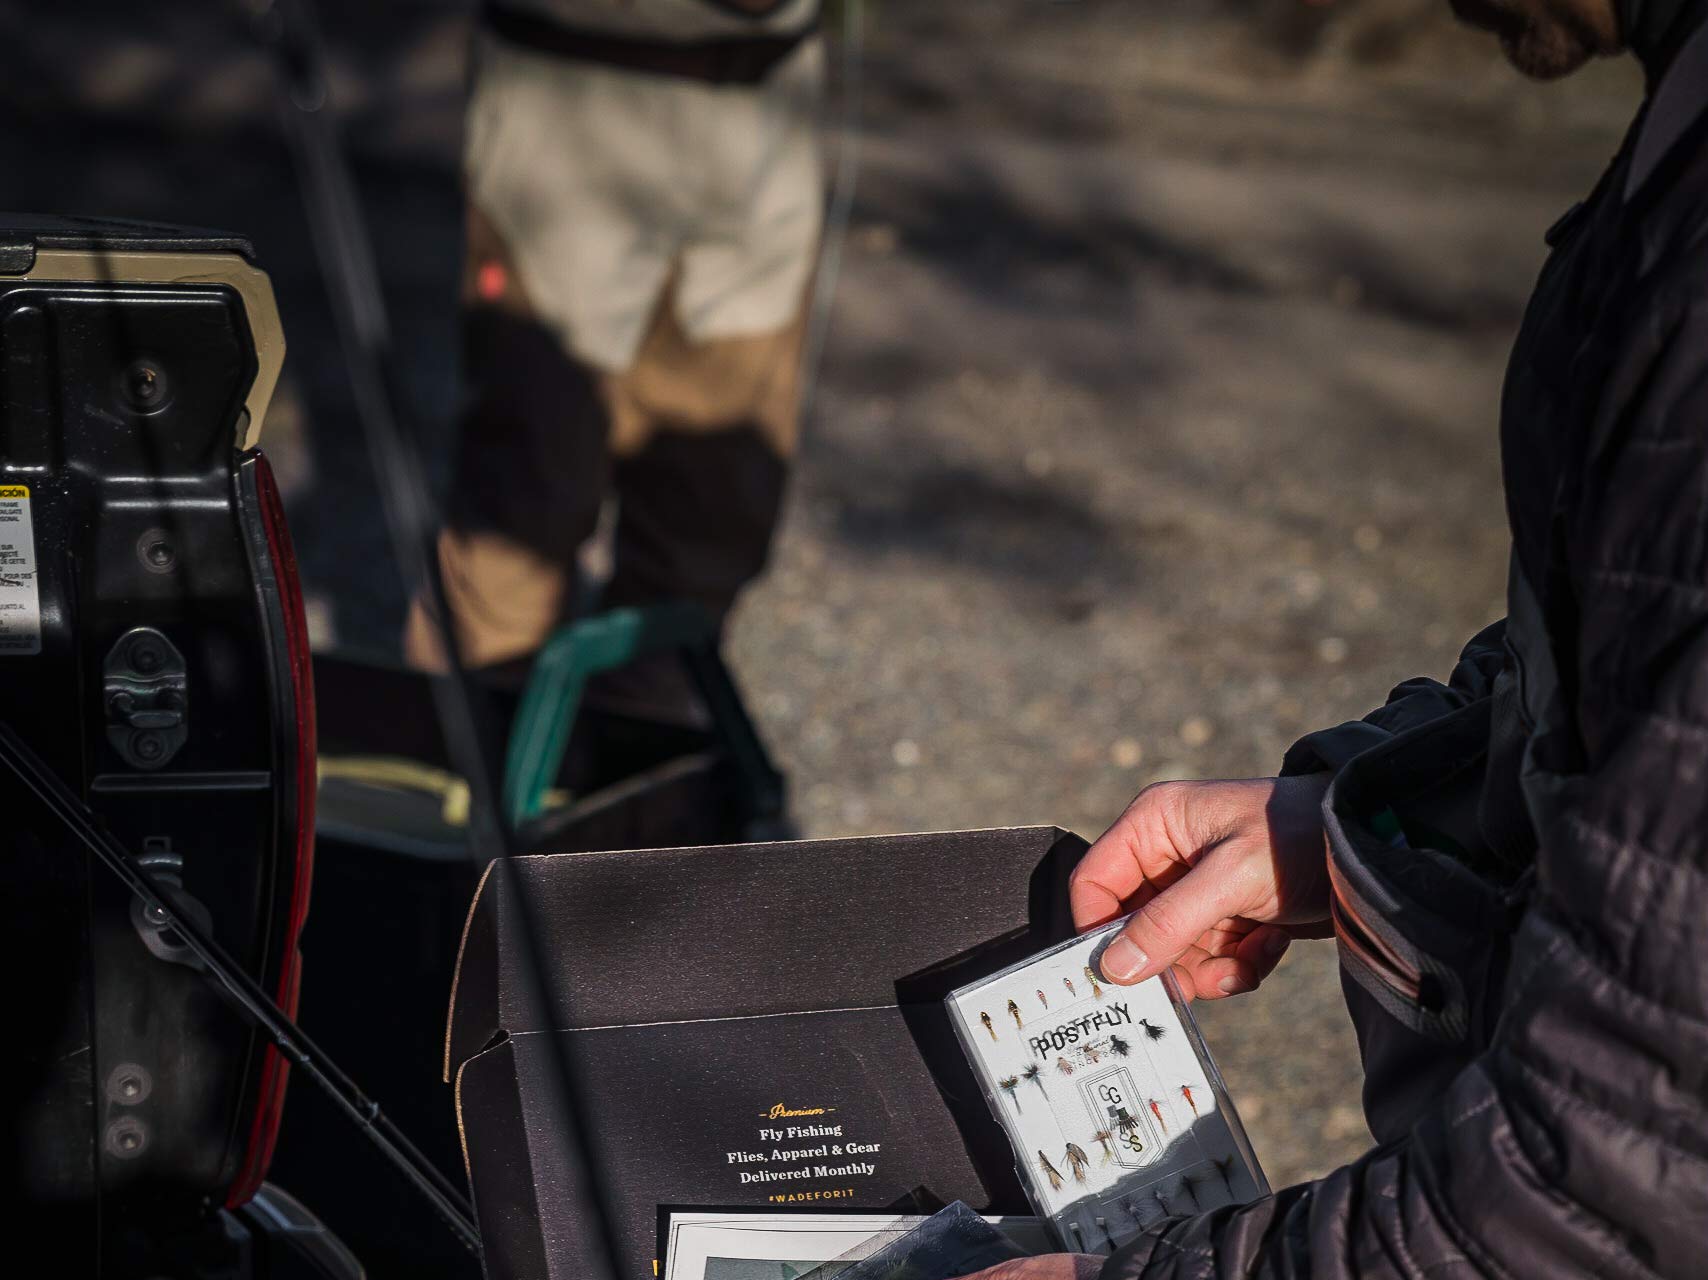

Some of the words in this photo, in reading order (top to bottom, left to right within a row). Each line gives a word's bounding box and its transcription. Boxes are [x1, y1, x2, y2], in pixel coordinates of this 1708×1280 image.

[1037, 1003, 1132, 1060] POSTFLY
[769, 1102, 825, 1120] Premium
[759, 1128, 784, 1142] Fly
[786, 1124, 843, 1139] Fishing
[726, 1151, 769, 1164] Flies,
[771, 1144, 828, 1162] Apparel
[831, 1144, 843, 1156] &
[845, 1142, 881, 1154] Gear
[740, 1167, 811, 1184] Delivered
[813, 1162, 876, 1178] Monthly
[768, 1189, 854, 1203] #WADEFORIT
